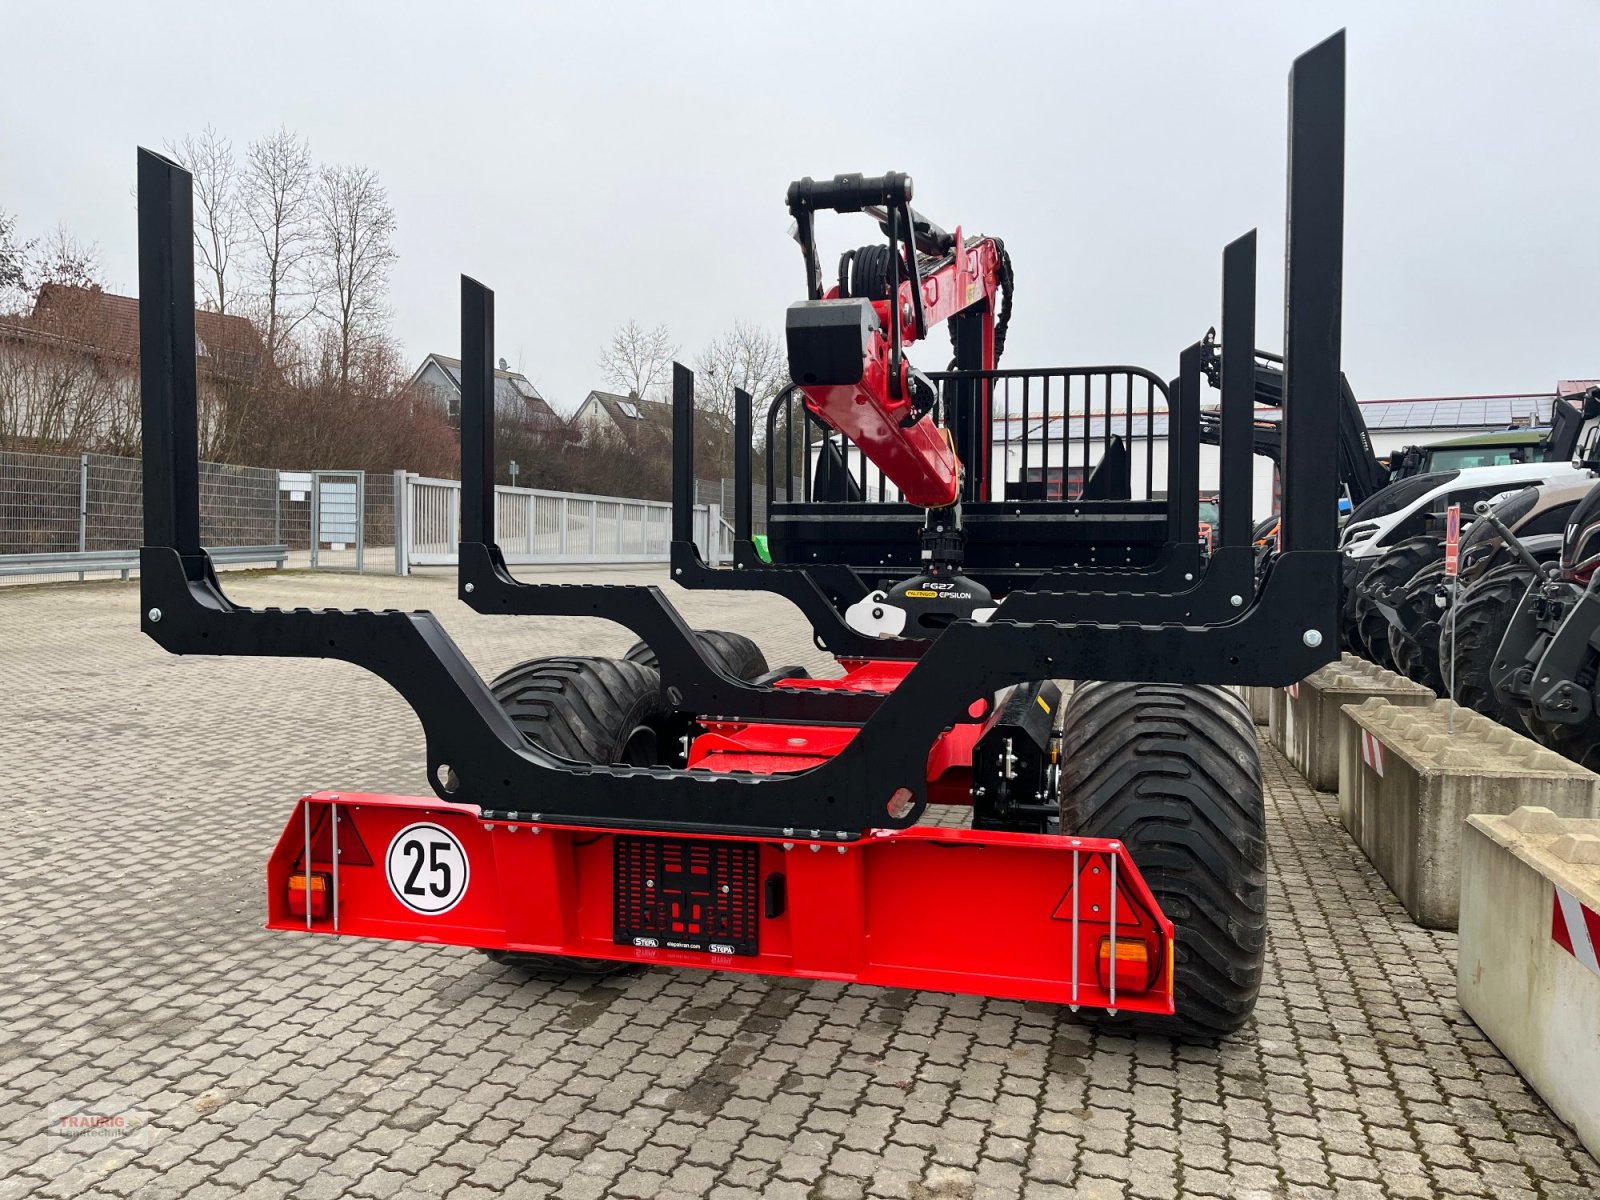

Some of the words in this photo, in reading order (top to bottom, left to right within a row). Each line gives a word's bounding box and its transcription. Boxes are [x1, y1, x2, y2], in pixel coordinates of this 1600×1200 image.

[922, 582, 954, 590] FG27
[939, 591, 971, 599] EPSILON
[403, 839, 451, 898] 25
[634, 937, 657, 947] STEPA
[710, 944, 733, 955] STEPA
